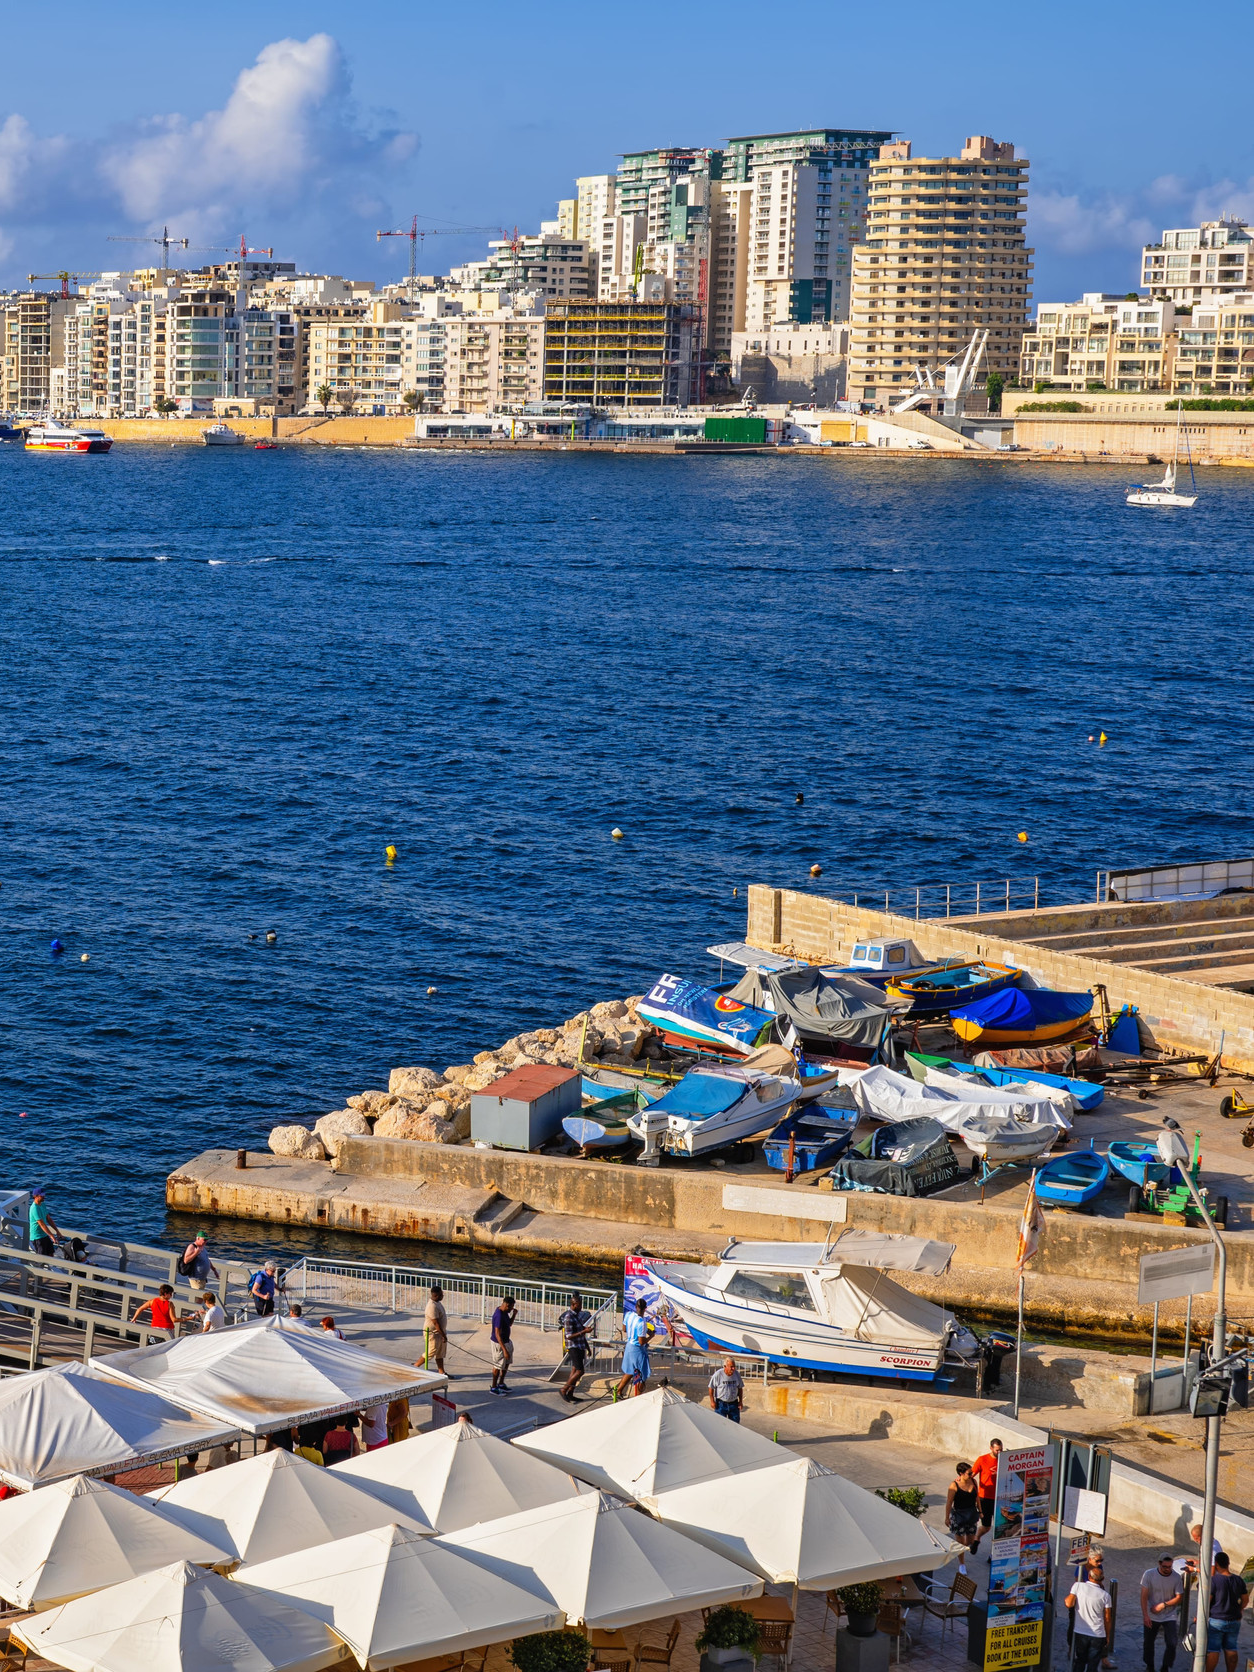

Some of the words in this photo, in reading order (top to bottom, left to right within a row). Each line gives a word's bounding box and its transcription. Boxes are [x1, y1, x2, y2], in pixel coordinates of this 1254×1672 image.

[879, 1355, 931, 1367] SCORPION
[320, 1400, 359, 1417] VALLETTA
[394, 1385, 421, 1398] FERRY
[183, 1439, 212, 1453] FERRY
[1008, 1450, 1045, 1463] CAPTAIN
[1007, 1459, 1044, 1472] MORGAN
[991, 1627, 1005, 1639] FREE
[1007, 1623, 1038, 1637] TRANSPORT
[990, 1641, 1002, 1651] FOR
[1002, 1639, 1013, 1649] ALL
[1014, 1635, 1037, 1647] CRUISES
[987, 1653, 1002, 1663] BOOK
[1003, 1651, 1011, 1660] AT
[1011, 1649, 1022, 1659] THE
[1023, 1646, 1039, 1657] KIOSK
